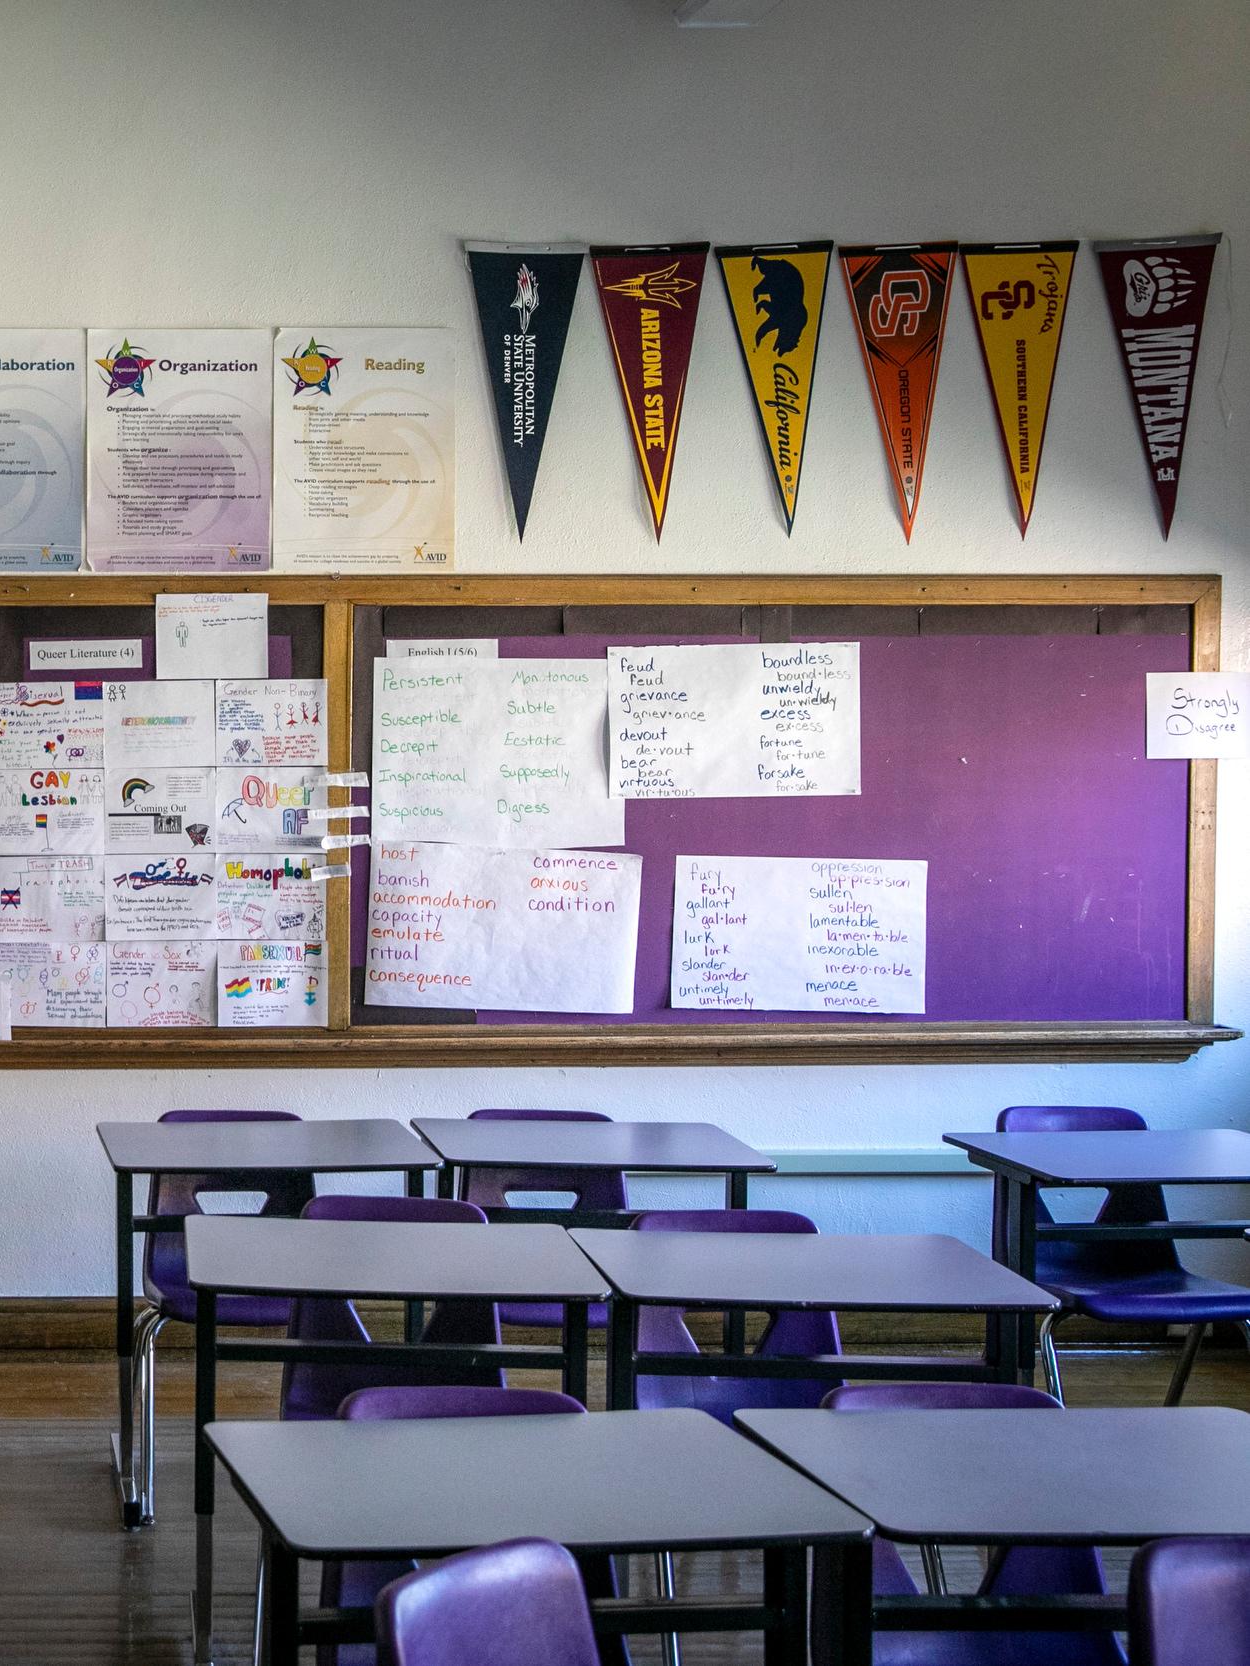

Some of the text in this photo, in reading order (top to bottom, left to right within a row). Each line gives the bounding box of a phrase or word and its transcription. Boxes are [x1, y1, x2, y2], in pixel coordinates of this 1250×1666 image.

[1036, 254, 1065, 336] Trojans
[504, 334, 510, 346] OF
[158, 359, 259, 374] Organization
[364, 358, 426, 374] Reading
[524, 334, 536, 436] METROPOLITAN
[641, 308, 665, 451] ARIZONA STATE
[513, 334, 524, 447] STATE UNIVERSITY
[1121, 323, 1196, 464] MONTANA
[106, 406, 149, 414] Organization
[764, 362, 799, 469] California
[1015, 339, 1031, 475] SOUTHERN CALIFORNIA
[898, 369, 913, 469] OREGON STATE
[52, 554, 74, 562] AVID
[425, 553, 447, 561] AVID
[37, 648, 134, 661] Queer Literature (4)
[408, 648, 478, 657] English (5/6)
[762, 648, 833, 669] boundless
[620, 657, 655, 673] feud
[382, 668, 463, 692] Persistent
[630, 670, 664, 687] feud
[762, 681, 821, 697] unwieldy
[507, 700, 557, 715] Subtle
[620, 690, 688, 713] grievance
[1171, 687, 1240, 718] Strongly
[381, 709, 463, 728] Susceptible
[760, 707, 811, 720] excess
[619, 727, 668, 742] devout
[1166, 714, 1237, 740] Disagree
[380, 739, 438, 756] Decrepit
[504, 732, 567, 747] Ecstatic
[759, 735, 803, 750] fortune
[620, 756, 657, 769] bear
[30, 770, 71, 789] GAY
[379, 768, 467, 789] Inspirational
[499, 764, 570, 787] Supposedly
[757, 763, 806, 780] forsake
[619, 777, 675, 788] virtuous
[21, 793, 78, 807] Lesbian
[241, 775, 315, 808] Queer
[134, 803, 187, 815] Coming Out
[379, 803, 444, 820] Suspicious
[497, 799, 550, 822] Digress
[283, 808, 310, 836] AF
[381, 847, 419, 861] host
[533, 855, 619, 871] commence
[811, 862, 883, 878] oppression
[377, 869, 430, 888] banish
[691, 862, 722, 887] fury
[530, 876, 589, 892] anxious
[809, 884, 853, 900] sullen
[373, 890, 497, 911] accommodation
[528, 896, 616, 913] condition
[686, 899, 731, 918] gallant
[372, 910, 442, 931] capacity
[809, 913, 880, 930] lamentable
[371, 926, 445, 942] emulate
[113, 942, 145, 960] Gender
[370, 944, 419, 962] ritual
[807, 943, 879, 957] inexorable
[681, 957, 726, 972] slander
[369, 969, 473, 992] consequence
[679, 979, 729, 998] untimely
[806, 980, 859, 993] menace
